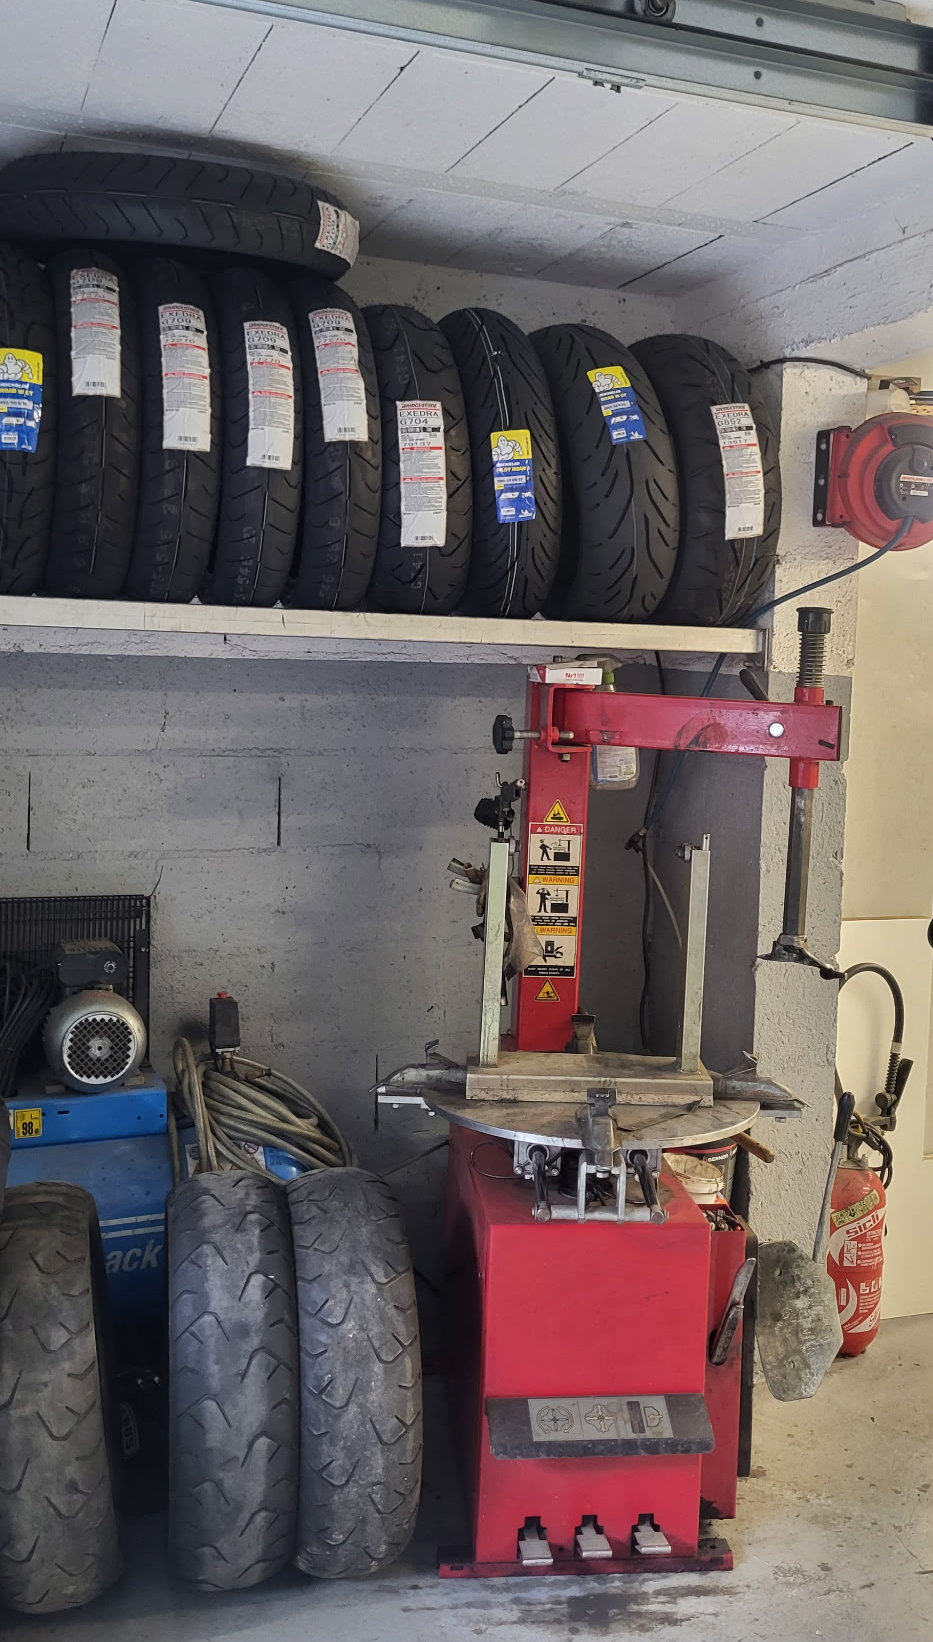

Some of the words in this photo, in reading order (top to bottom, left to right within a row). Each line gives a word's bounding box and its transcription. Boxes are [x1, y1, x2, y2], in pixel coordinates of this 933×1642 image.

[161, 311, 202, 321] EXEDRA
[247, 330, 285, 340] EXEDRA
[715, 411, 750, 420] EXEDRA
[717, 418, 741, 426] G852
[544, 826, 577, 834] DANGER
[541, 876, 575, 884] WARNING
[22, 1121, 33, 1136] 98
[845, 1211, 880, 1238] sicli
